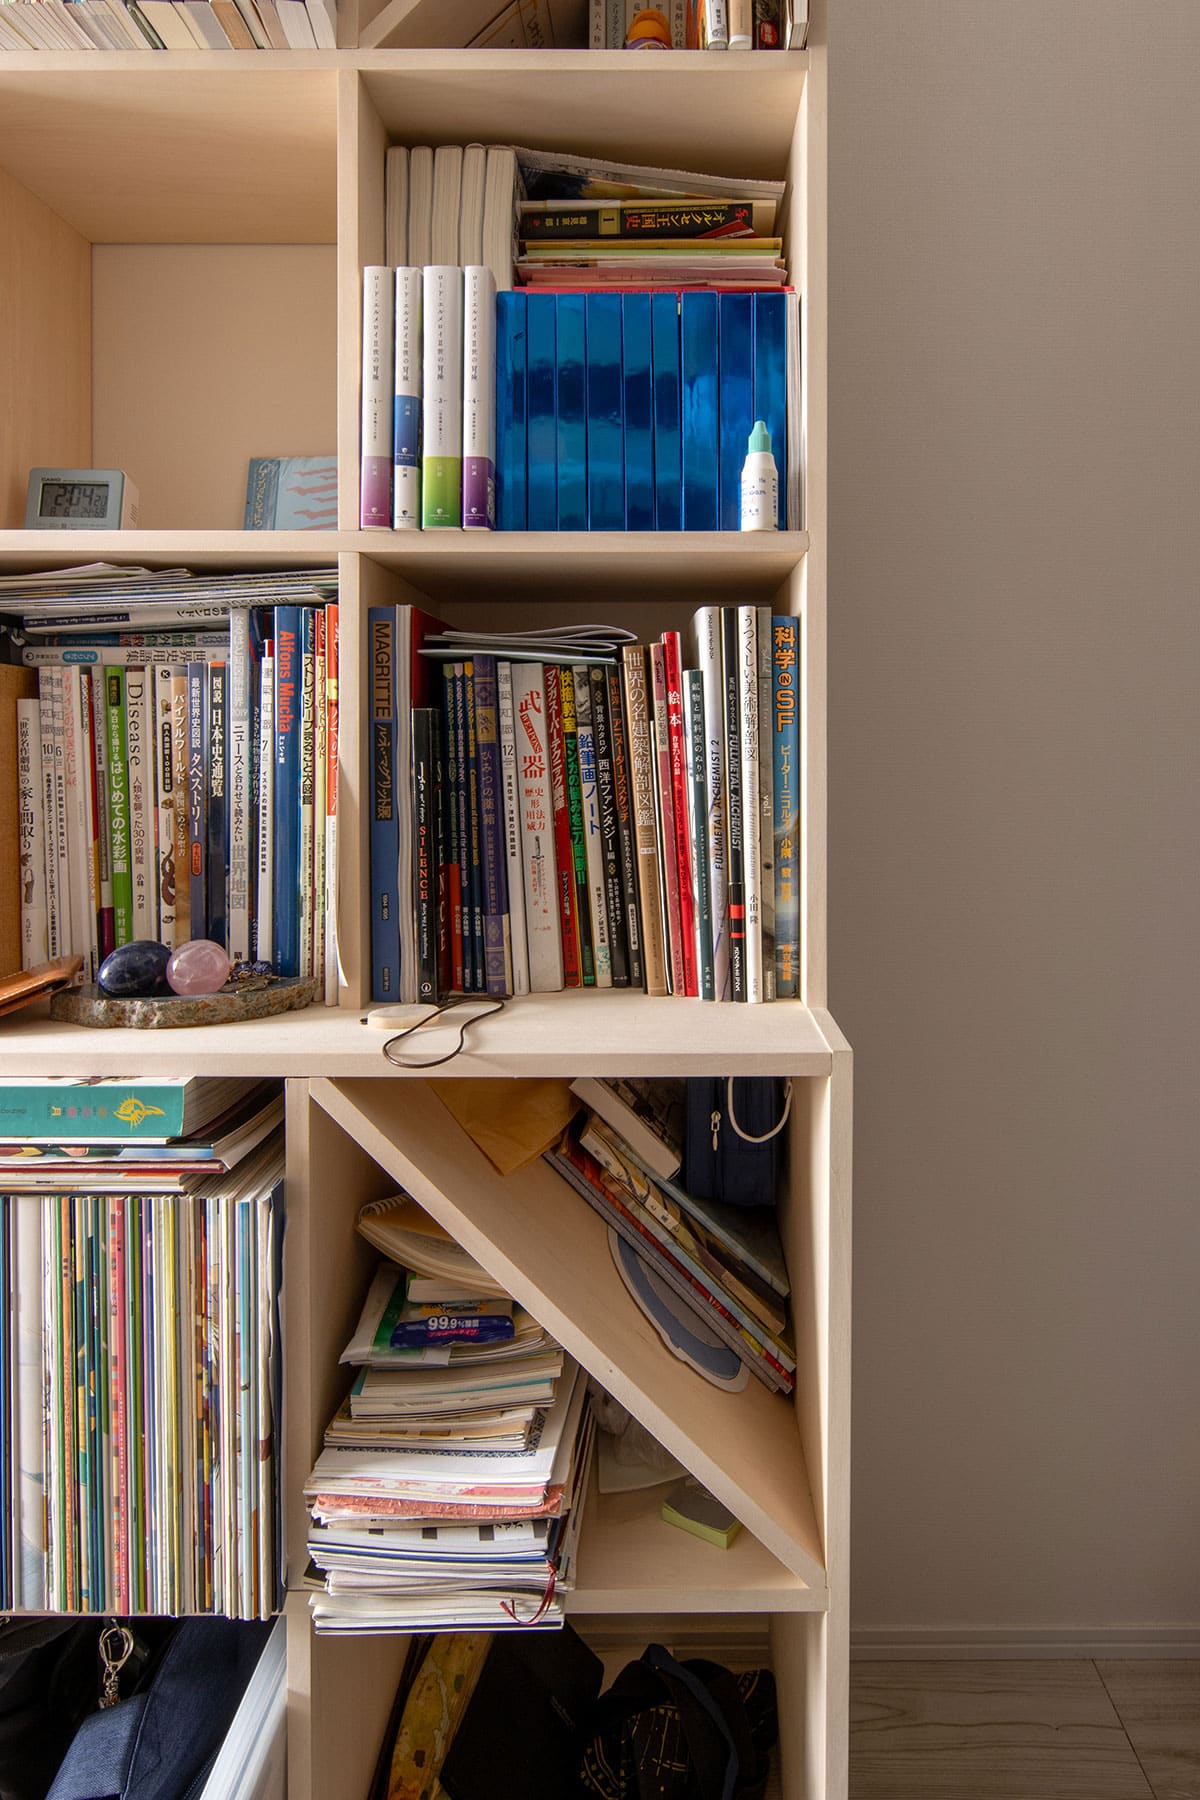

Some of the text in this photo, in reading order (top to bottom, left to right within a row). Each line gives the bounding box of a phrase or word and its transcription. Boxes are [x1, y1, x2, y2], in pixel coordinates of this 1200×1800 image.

[625, 211, 726, 230] オルクセン王国史
[126, 650, 206, 663] 世界史用語集
[279, 630, 295, 733] Alfons Mucha
[375, 623, 391, 717] MAGRITTE
[743, 616, 757, 762] うつくしい美術解剖図
[774, 626, 796, 733] 科学 IN SF
[127, 682, 144, 766] Disease
[191, 677, 201, 749] 最新世界史図説
[211, 676, 223, 798] 図説 日本史通覧
[518, 690, 542, 714] 武
[520, 713, 543, 755] WEAPONS
[560, 671, 577, 733] 快描教室
[595, 704, 608, 755] 背景カタログ
[668, 691, 682, 728] 絵本
[692, 682, 705, 783] 鉱物と理科室のぬり絵
[42, 743, 53, 755] 10
[55, 746, 62, 757] 6
[174, 695, 186, 784] バイブルワールド
[262, 740, 268, 751] 7
[376, 724, 391, 820] ルネ・マグリット展
[503, 744, 514, 756] 12
[520, 754, 546, 779] 器
[628, 652, 656, 826] 世界の名建築解剖図鑑
[190, 752, 203, 836] タペストリー
[578, 733, 600, 836] 鉛筆画ノート
[711, 751, 724, 810] ALCHEMIST
[728, 734, 742, 852] FULLMETAL ALCHEMIST
[762, 794, 770, 818] vol.1
[133, 776, 145, 865] 人類を襲った30の病魔
[231, 725, 246, 910] ニュースと合わせて読みたい 世界地図
[711, 814, 725, 871] FULLMETAL
[418, 827, 428, 900] SILENCE
[750, 894, 759, 912] 小田
